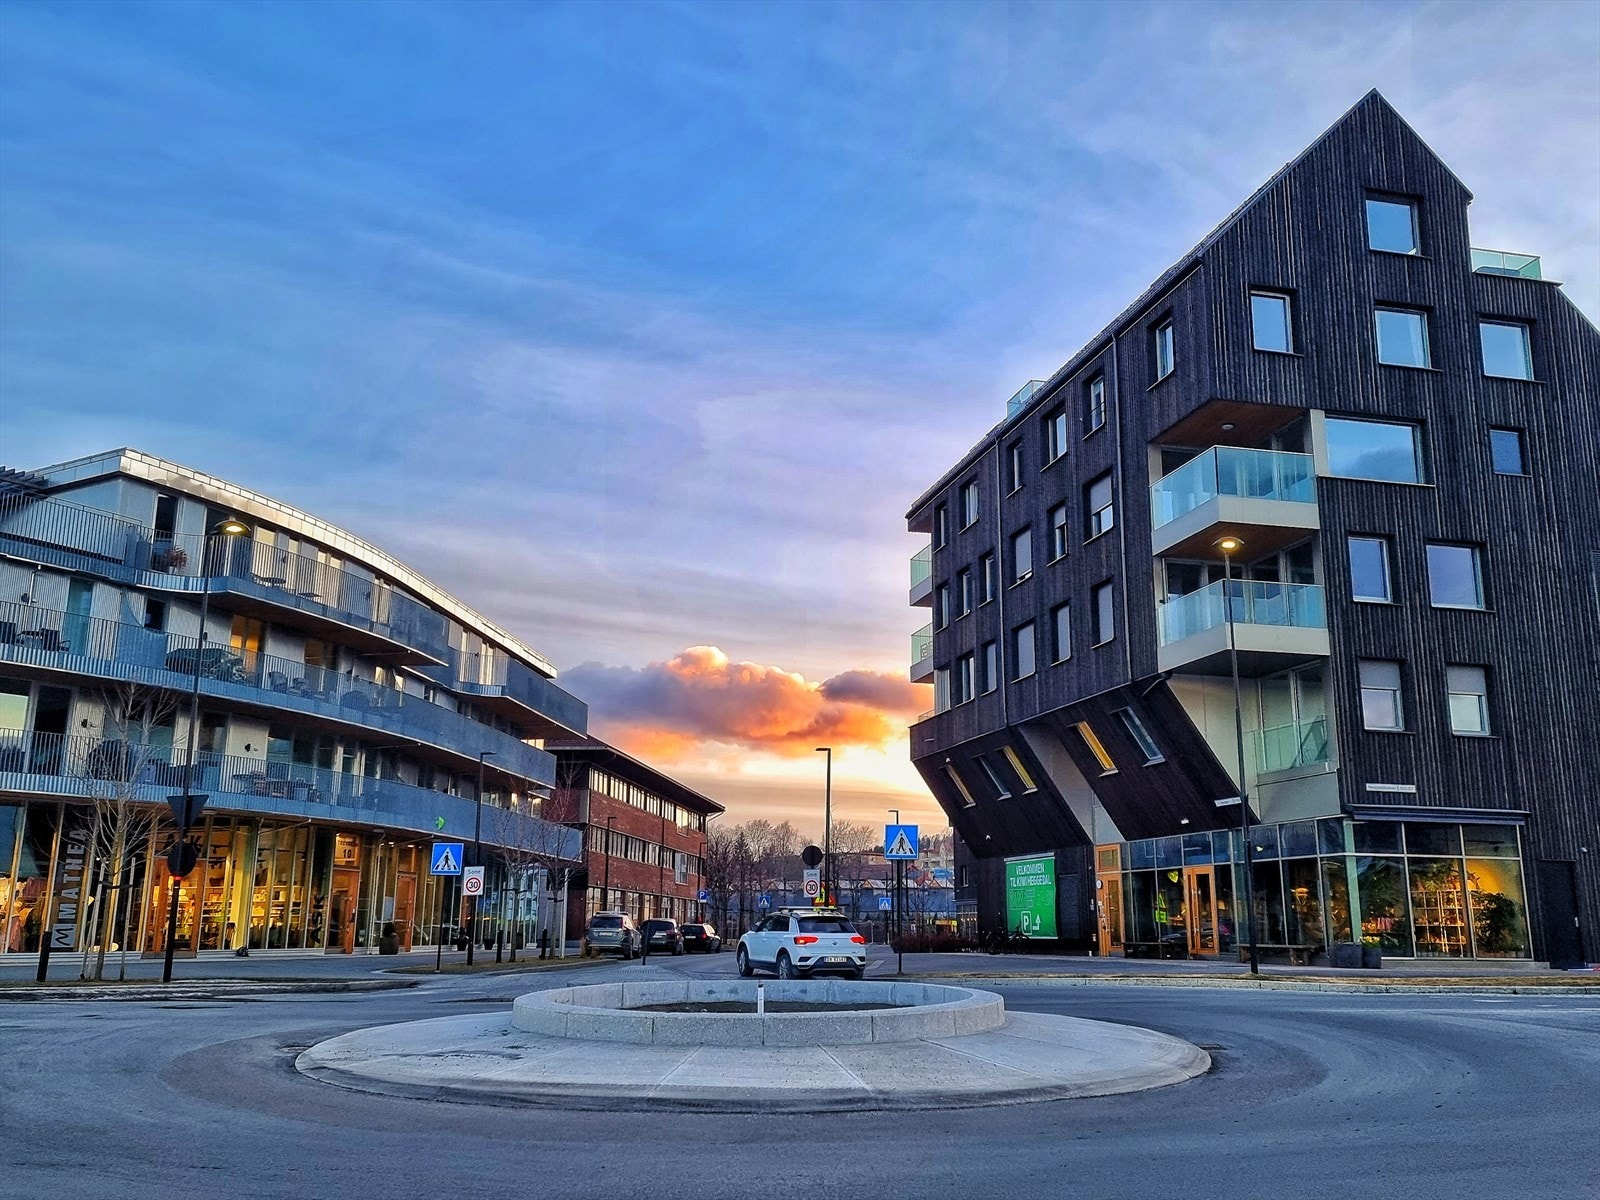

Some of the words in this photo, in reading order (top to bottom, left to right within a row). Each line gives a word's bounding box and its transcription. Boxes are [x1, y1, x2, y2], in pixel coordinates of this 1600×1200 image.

[58, 829, 87, 919] MATHEA
[1016, 863, 1045, 875] VELKOMMEN
[468, 880, 479, 889] 30
[808, 883, 816, 892] 30
[1009, 877, 1017, 887] TIL
[1023, 915, 1029, 931] P
